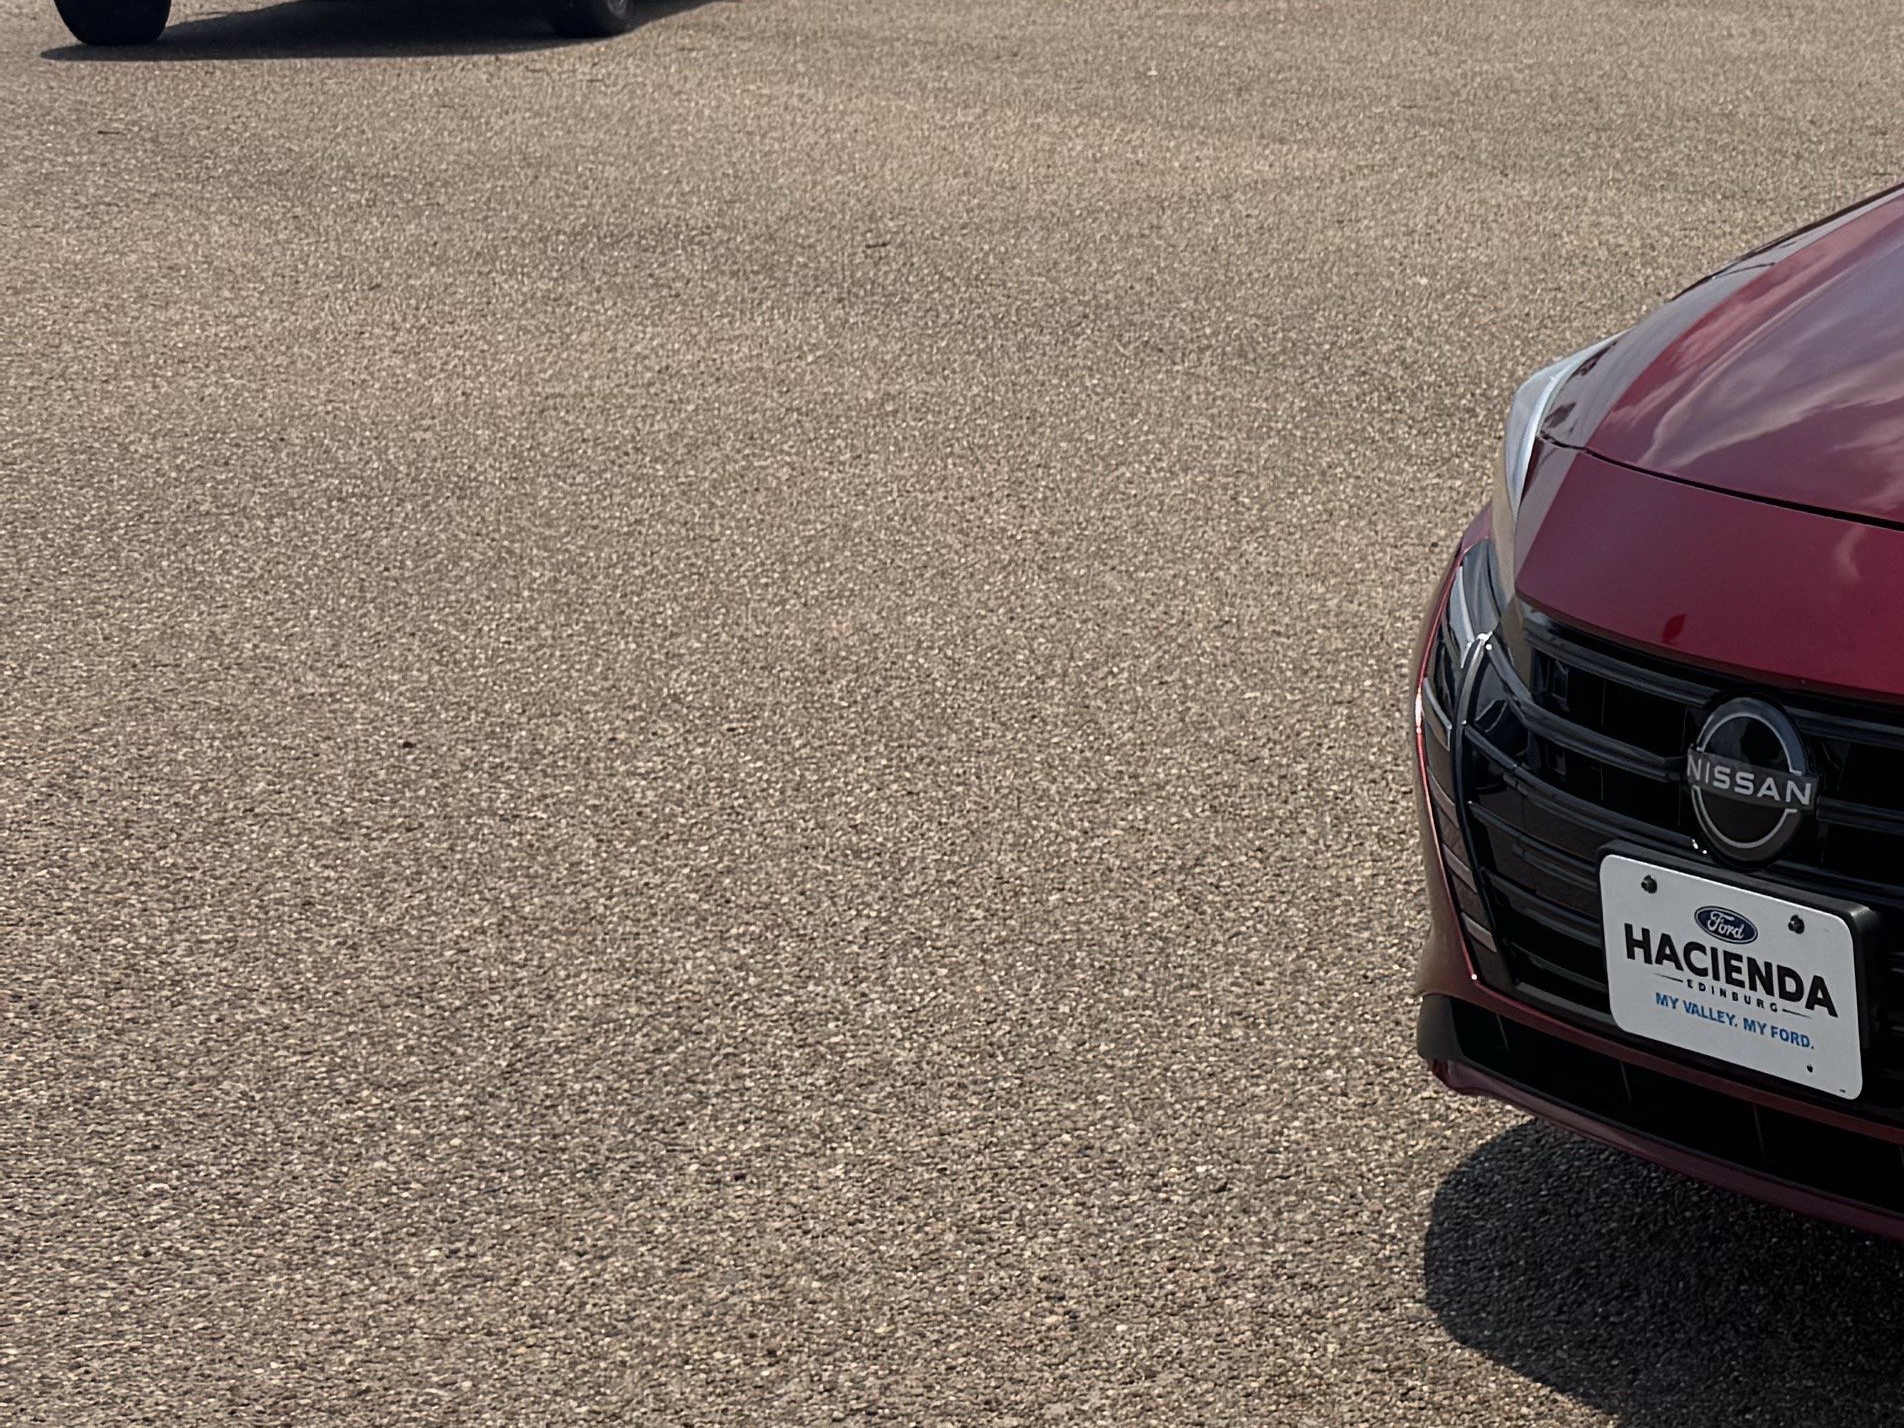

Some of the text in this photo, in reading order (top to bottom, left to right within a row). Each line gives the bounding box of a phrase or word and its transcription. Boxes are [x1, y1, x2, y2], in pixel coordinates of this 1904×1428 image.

[1685, 756, 1813, 807] NISSAN
[1706, 911, 1746, 940] Ford
[1623, 922, 1839, 1019] HACIENDA
[1686, 978, 1779, 1013] EDINBURG
[1655, 992, 1815, 1050] MY VALLEY. MY FORD.
